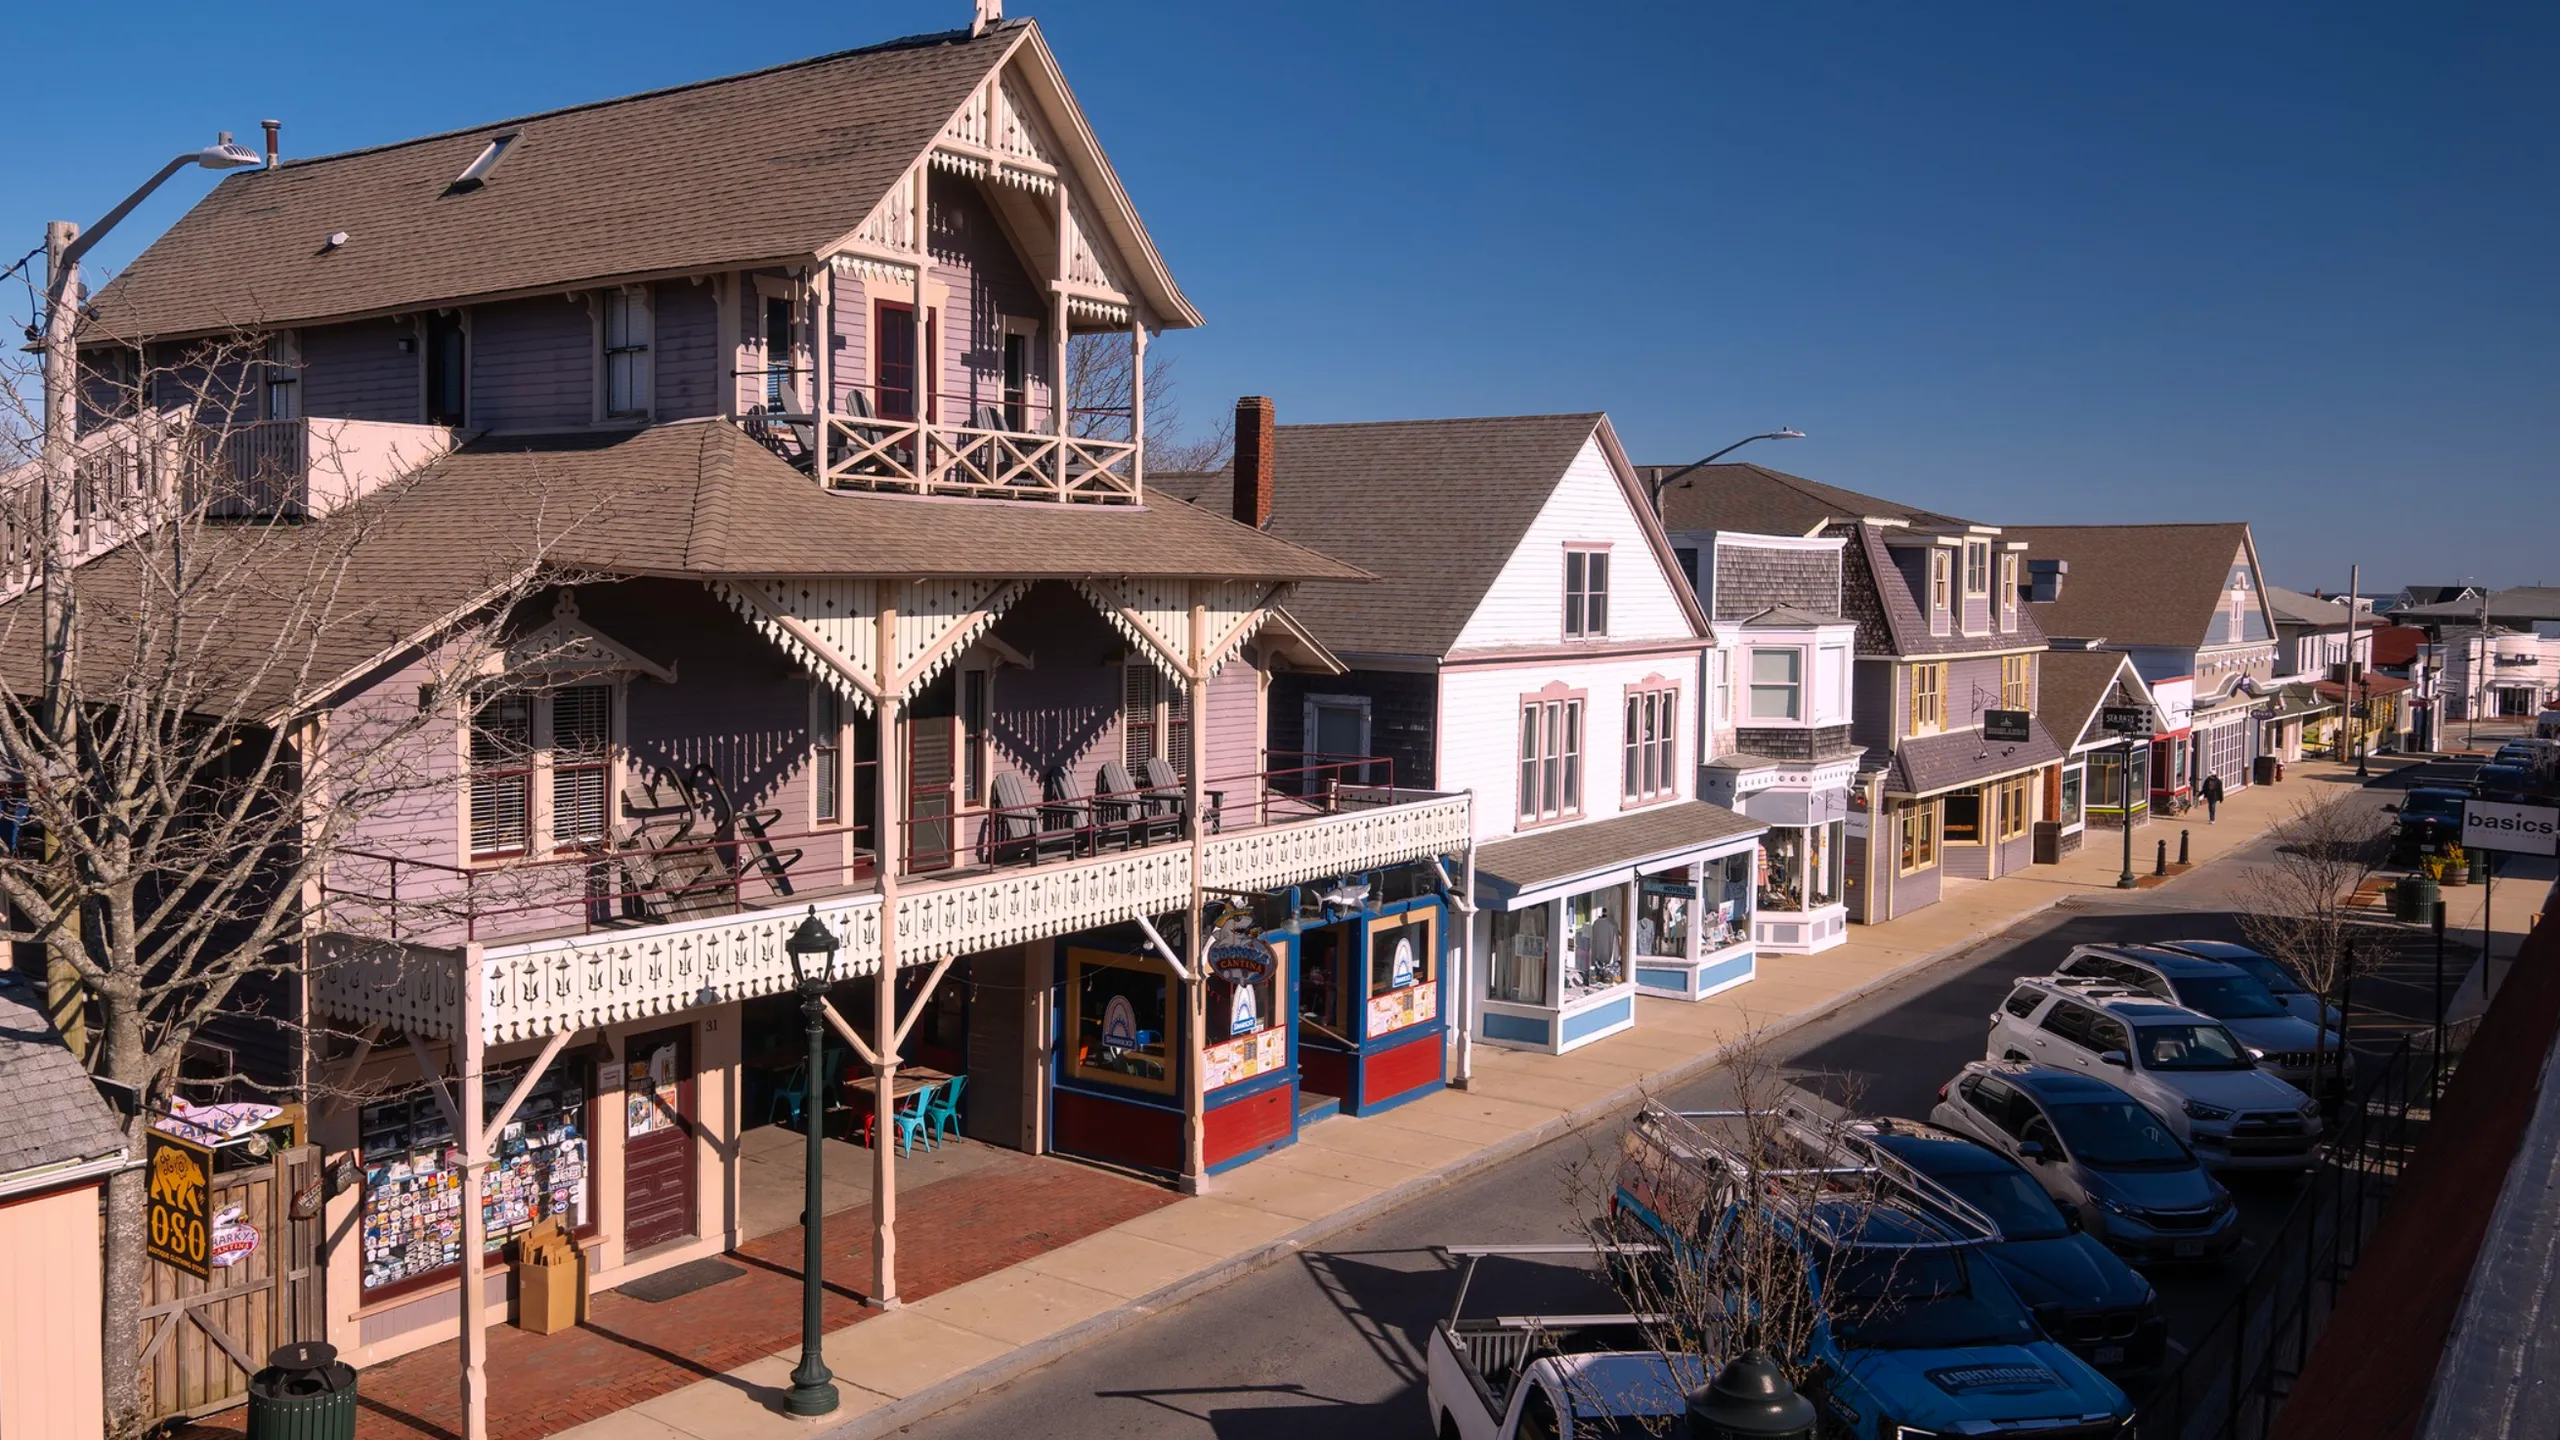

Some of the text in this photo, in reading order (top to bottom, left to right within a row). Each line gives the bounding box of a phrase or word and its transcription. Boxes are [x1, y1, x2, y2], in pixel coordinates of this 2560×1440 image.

[2468, 812, 2553, 834] basics
[1220, 959, 1262, 973] CANTINA
[705, 1019, 718, 1032] 31
[1938, 1368, 2053, 1386] LIGHTHOUSE
